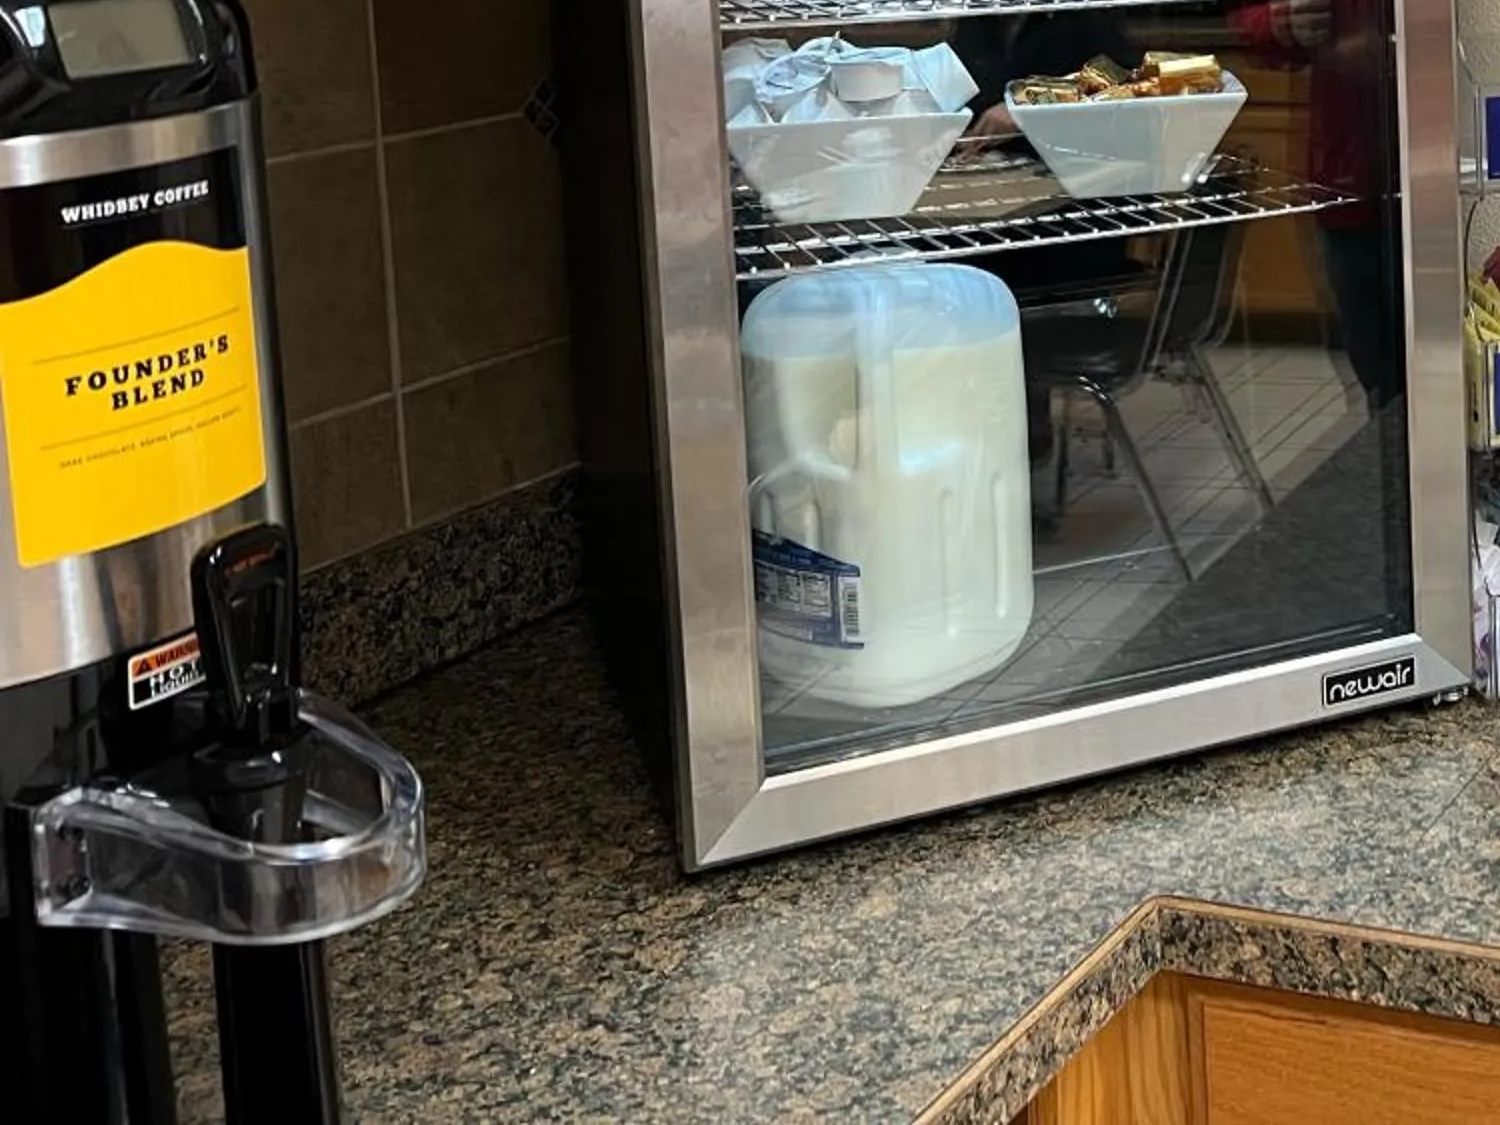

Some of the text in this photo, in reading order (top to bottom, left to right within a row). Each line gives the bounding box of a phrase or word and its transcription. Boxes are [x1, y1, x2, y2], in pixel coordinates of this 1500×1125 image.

[61, 179, 210, 224] WHIDBEY COFFEE
[65, 334, 230, 397] FOUNDER'S
[112, 367, 206, 411] BLEND
[155, 638, 199, 667] WARN
[1329, 662, 1411, 701] newair
